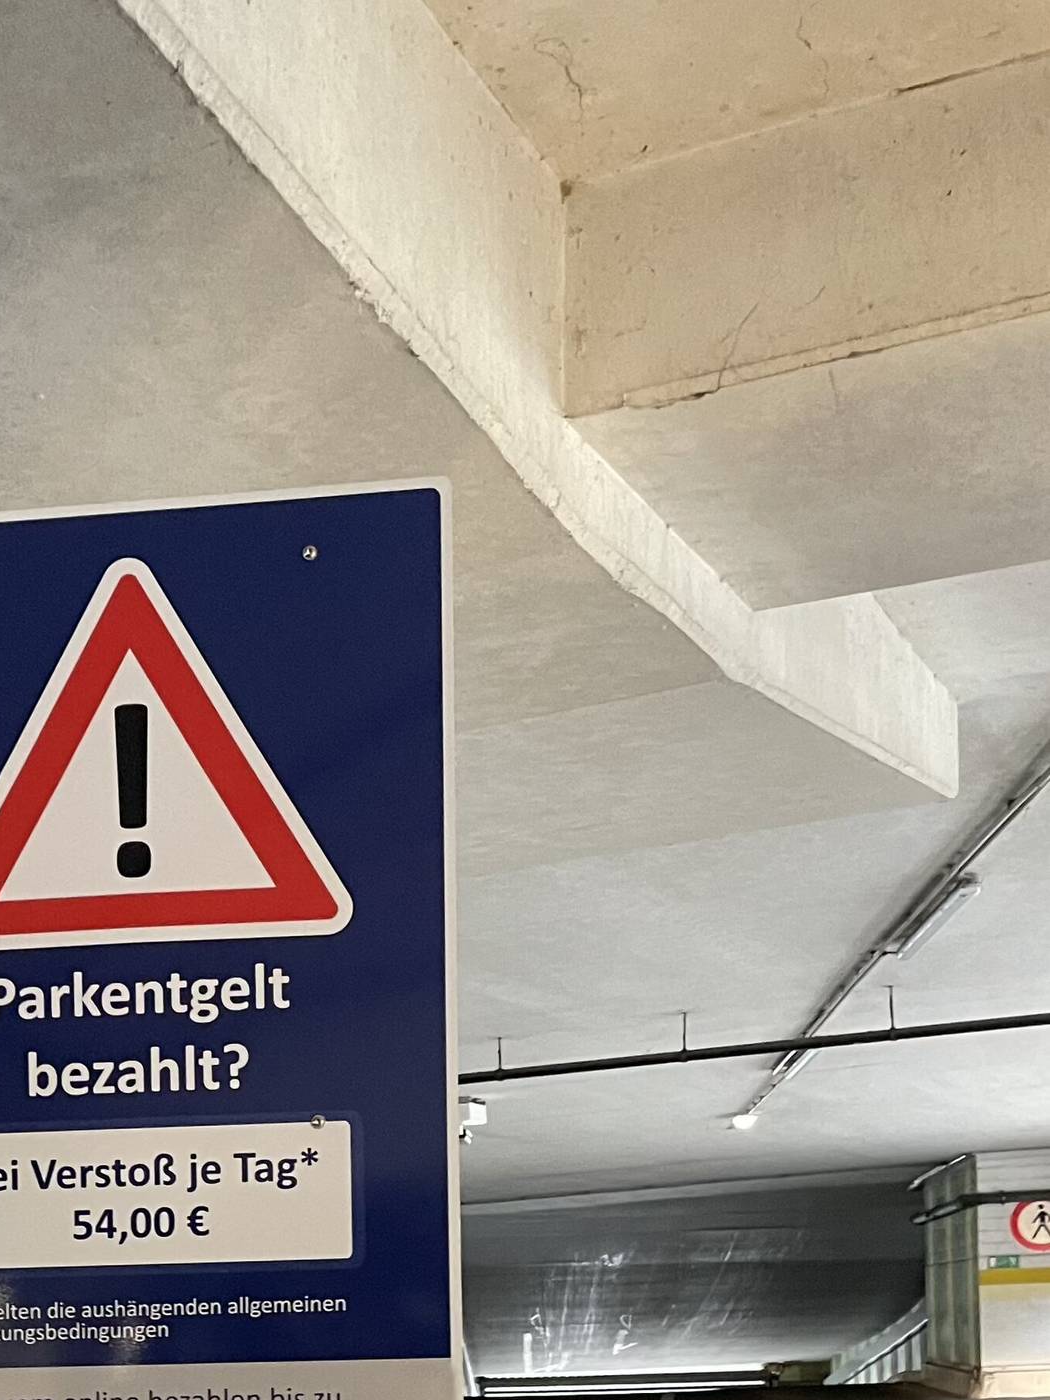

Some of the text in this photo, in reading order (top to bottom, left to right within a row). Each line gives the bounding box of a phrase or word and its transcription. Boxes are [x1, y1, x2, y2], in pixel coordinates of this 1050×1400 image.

[27, 1043, 250, 1097] bezahlt?
[30, 1153, 177, 1190] Verstoß
[186, 1154, 222, 1193] je
[72, 1205, 210, 1245] 54,00 €
[47, 1301, 76, 1319] die
[81, 1298, 223, 1323] aushängenden
[227, 1295, 347, 1318] allgemeinen
